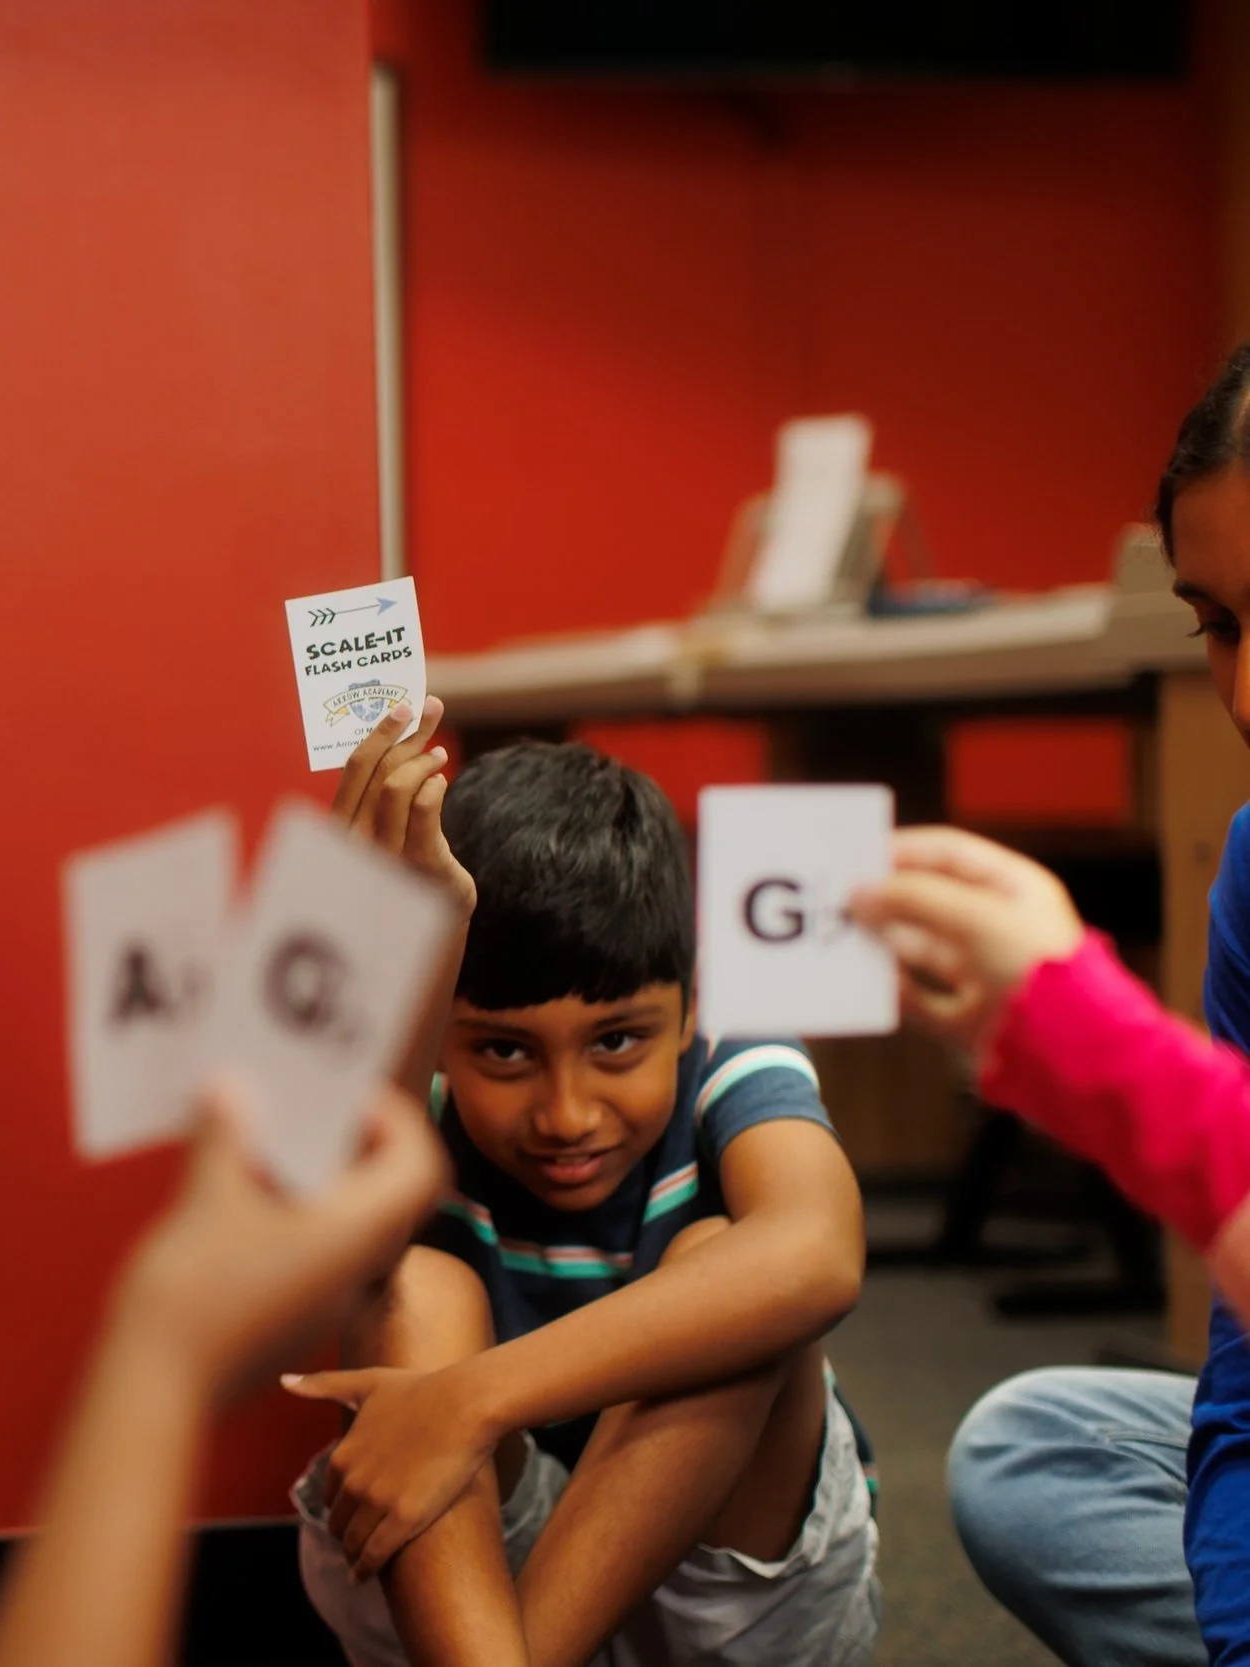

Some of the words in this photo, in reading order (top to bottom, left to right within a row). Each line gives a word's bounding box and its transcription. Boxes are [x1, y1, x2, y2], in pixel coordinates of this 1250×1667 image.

[306, 627, 406, 660] SCALE-IT
[305, 659, 352, 676] FLASH
[357, 646, 412, 668] CARDS
[333, 691, 360, 708] ARROW
[363, 687, 399, 698] ACADEMY
[741, 875, 807, 944] G
